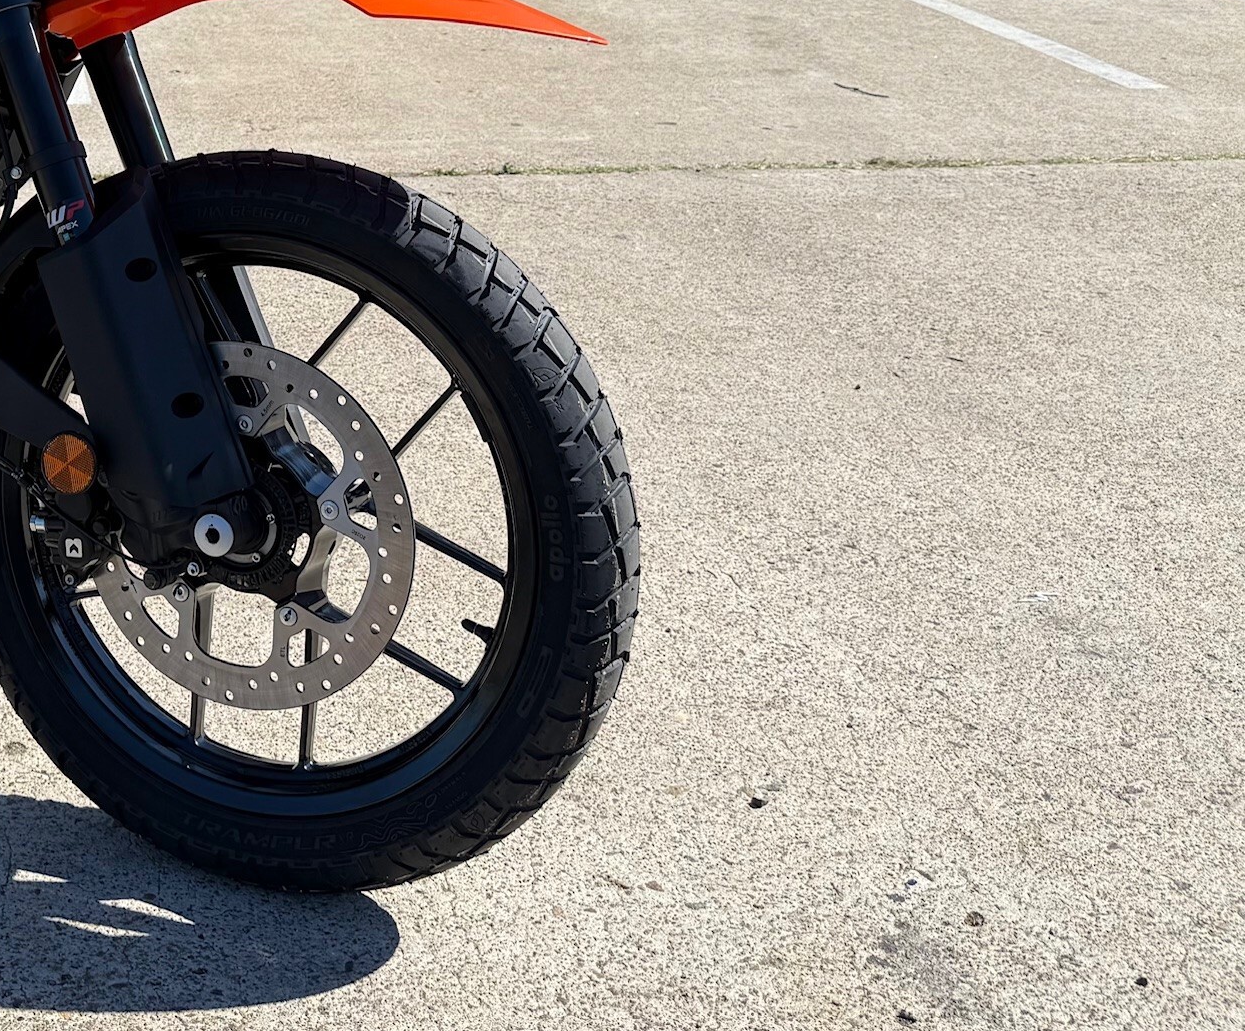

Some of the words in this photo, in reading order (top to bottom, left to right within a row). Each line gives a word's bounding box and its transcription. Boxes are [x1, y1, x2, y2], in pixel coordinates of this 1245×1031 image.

[46, 197, 85, 229] WP
[57, 220, 79, 235] APEX
[541, 494, 571, 583] apollo
